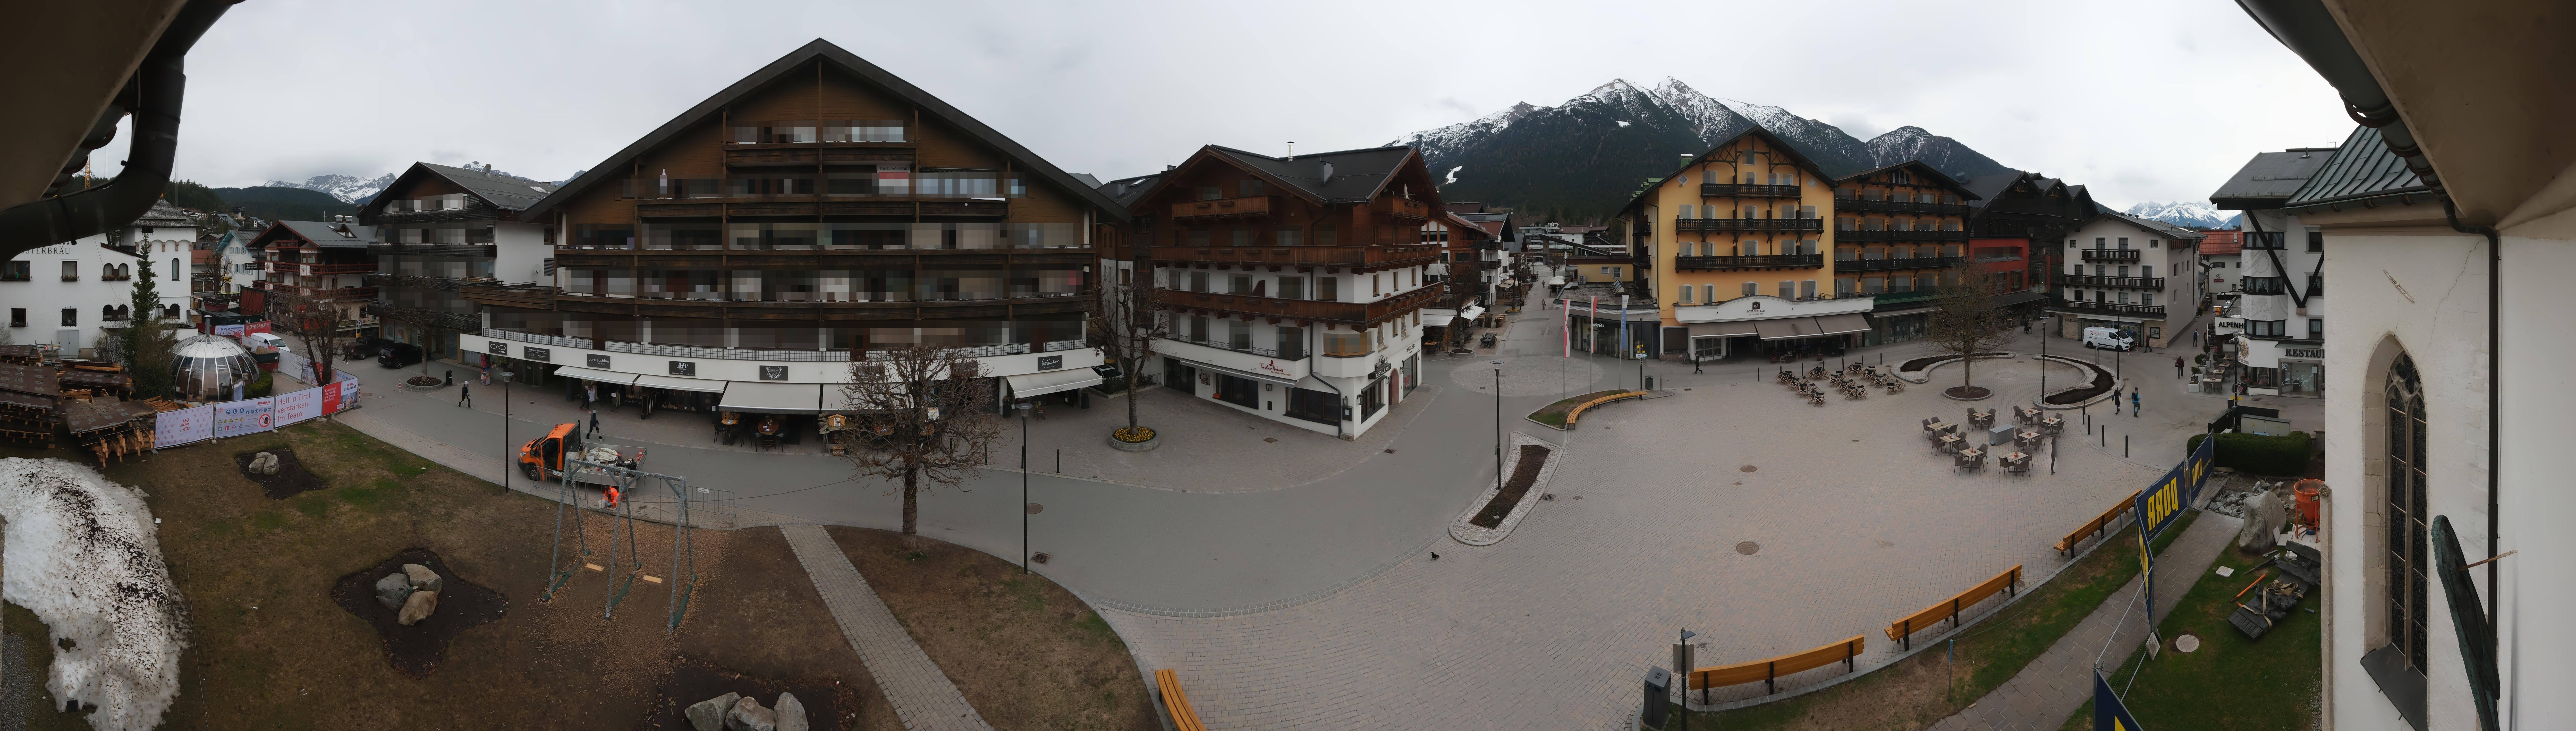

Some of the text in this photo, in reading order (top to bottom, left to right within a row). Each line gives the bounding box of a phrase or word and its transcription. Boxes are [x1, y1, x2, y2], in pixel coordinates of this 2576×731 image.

[1406, 344, 1415, 352] SAILER
[677, 362, 688, 372] My
[1376, 365, 1390, 378] RESTAURANT
[278, 397, 290, 405] Hall
[298, 392, 311, 400] Tirol
[278, 402, 309, 413] verstärken.
